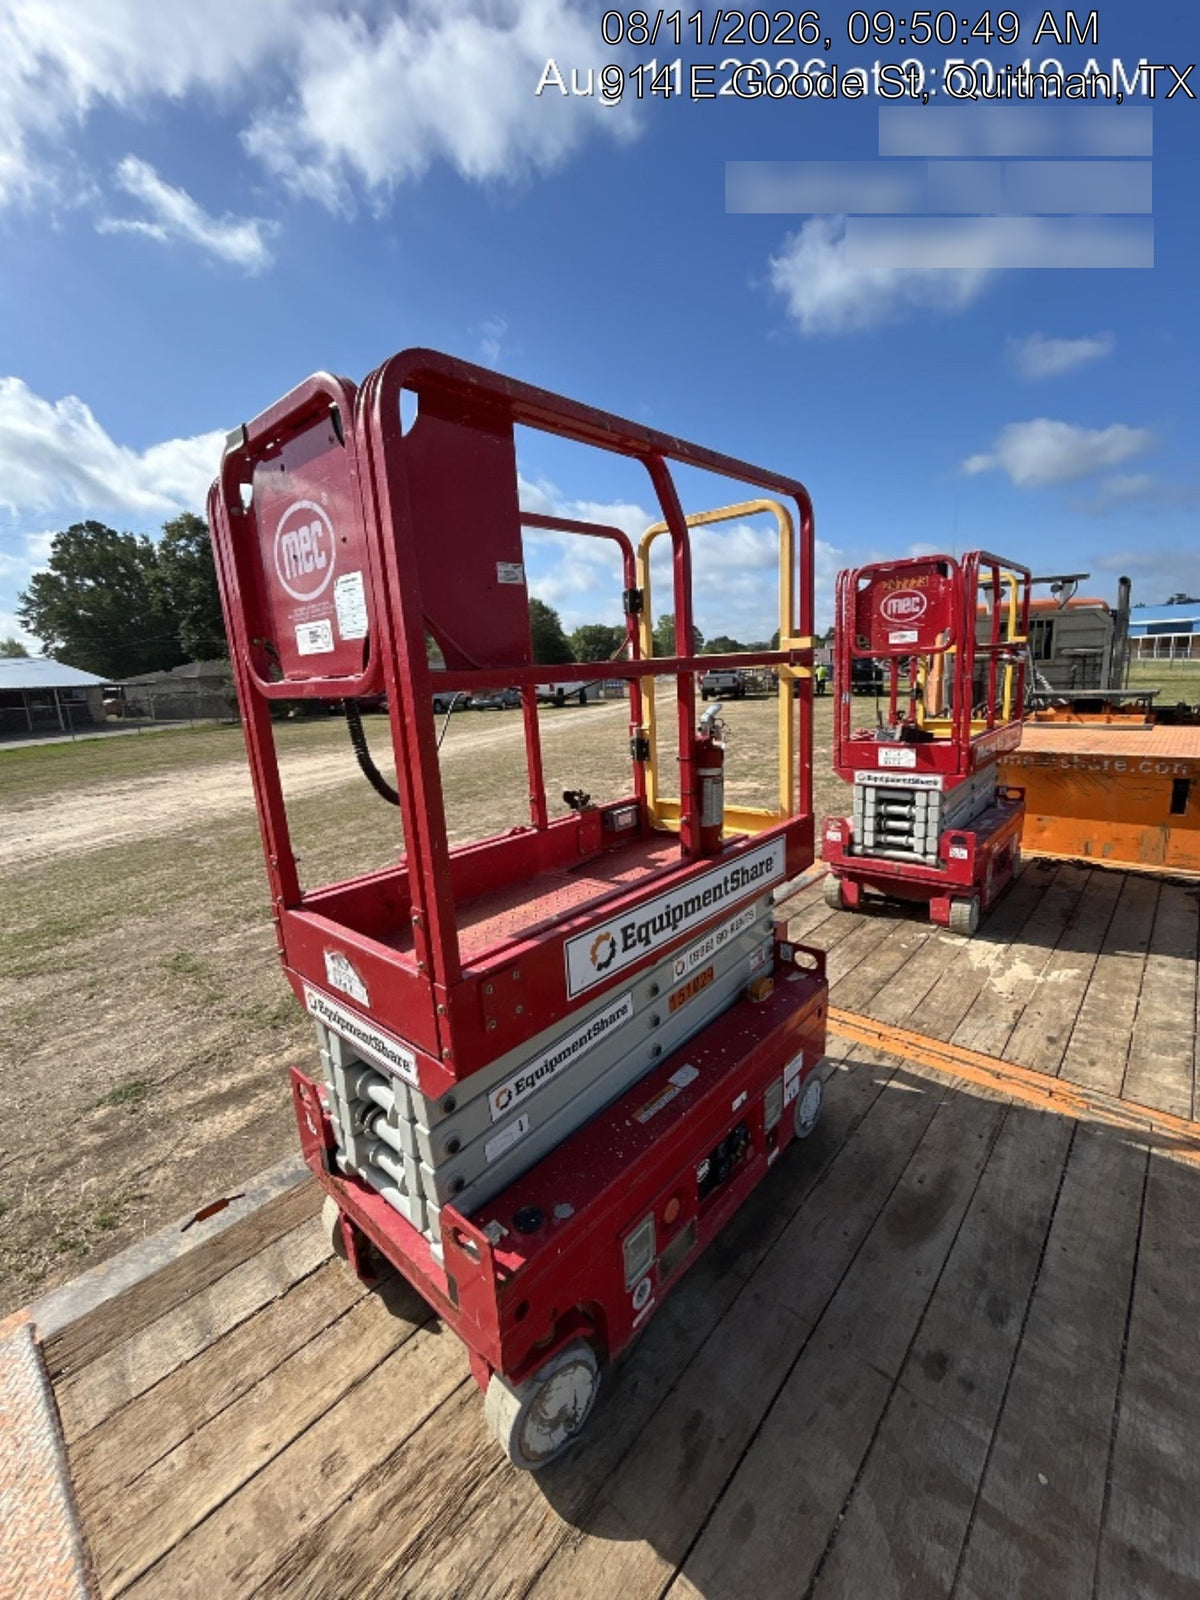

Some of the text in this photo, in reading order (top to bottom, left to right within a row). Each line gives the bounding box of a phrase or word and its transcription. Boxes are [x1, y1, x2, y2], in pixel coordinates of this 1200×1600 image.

[620, 855, 775, 953] EquipmentShare
[317, 999, 413, 1073] EquipmentShare
[513, 1004, 630, 1096] EquipmentShare
